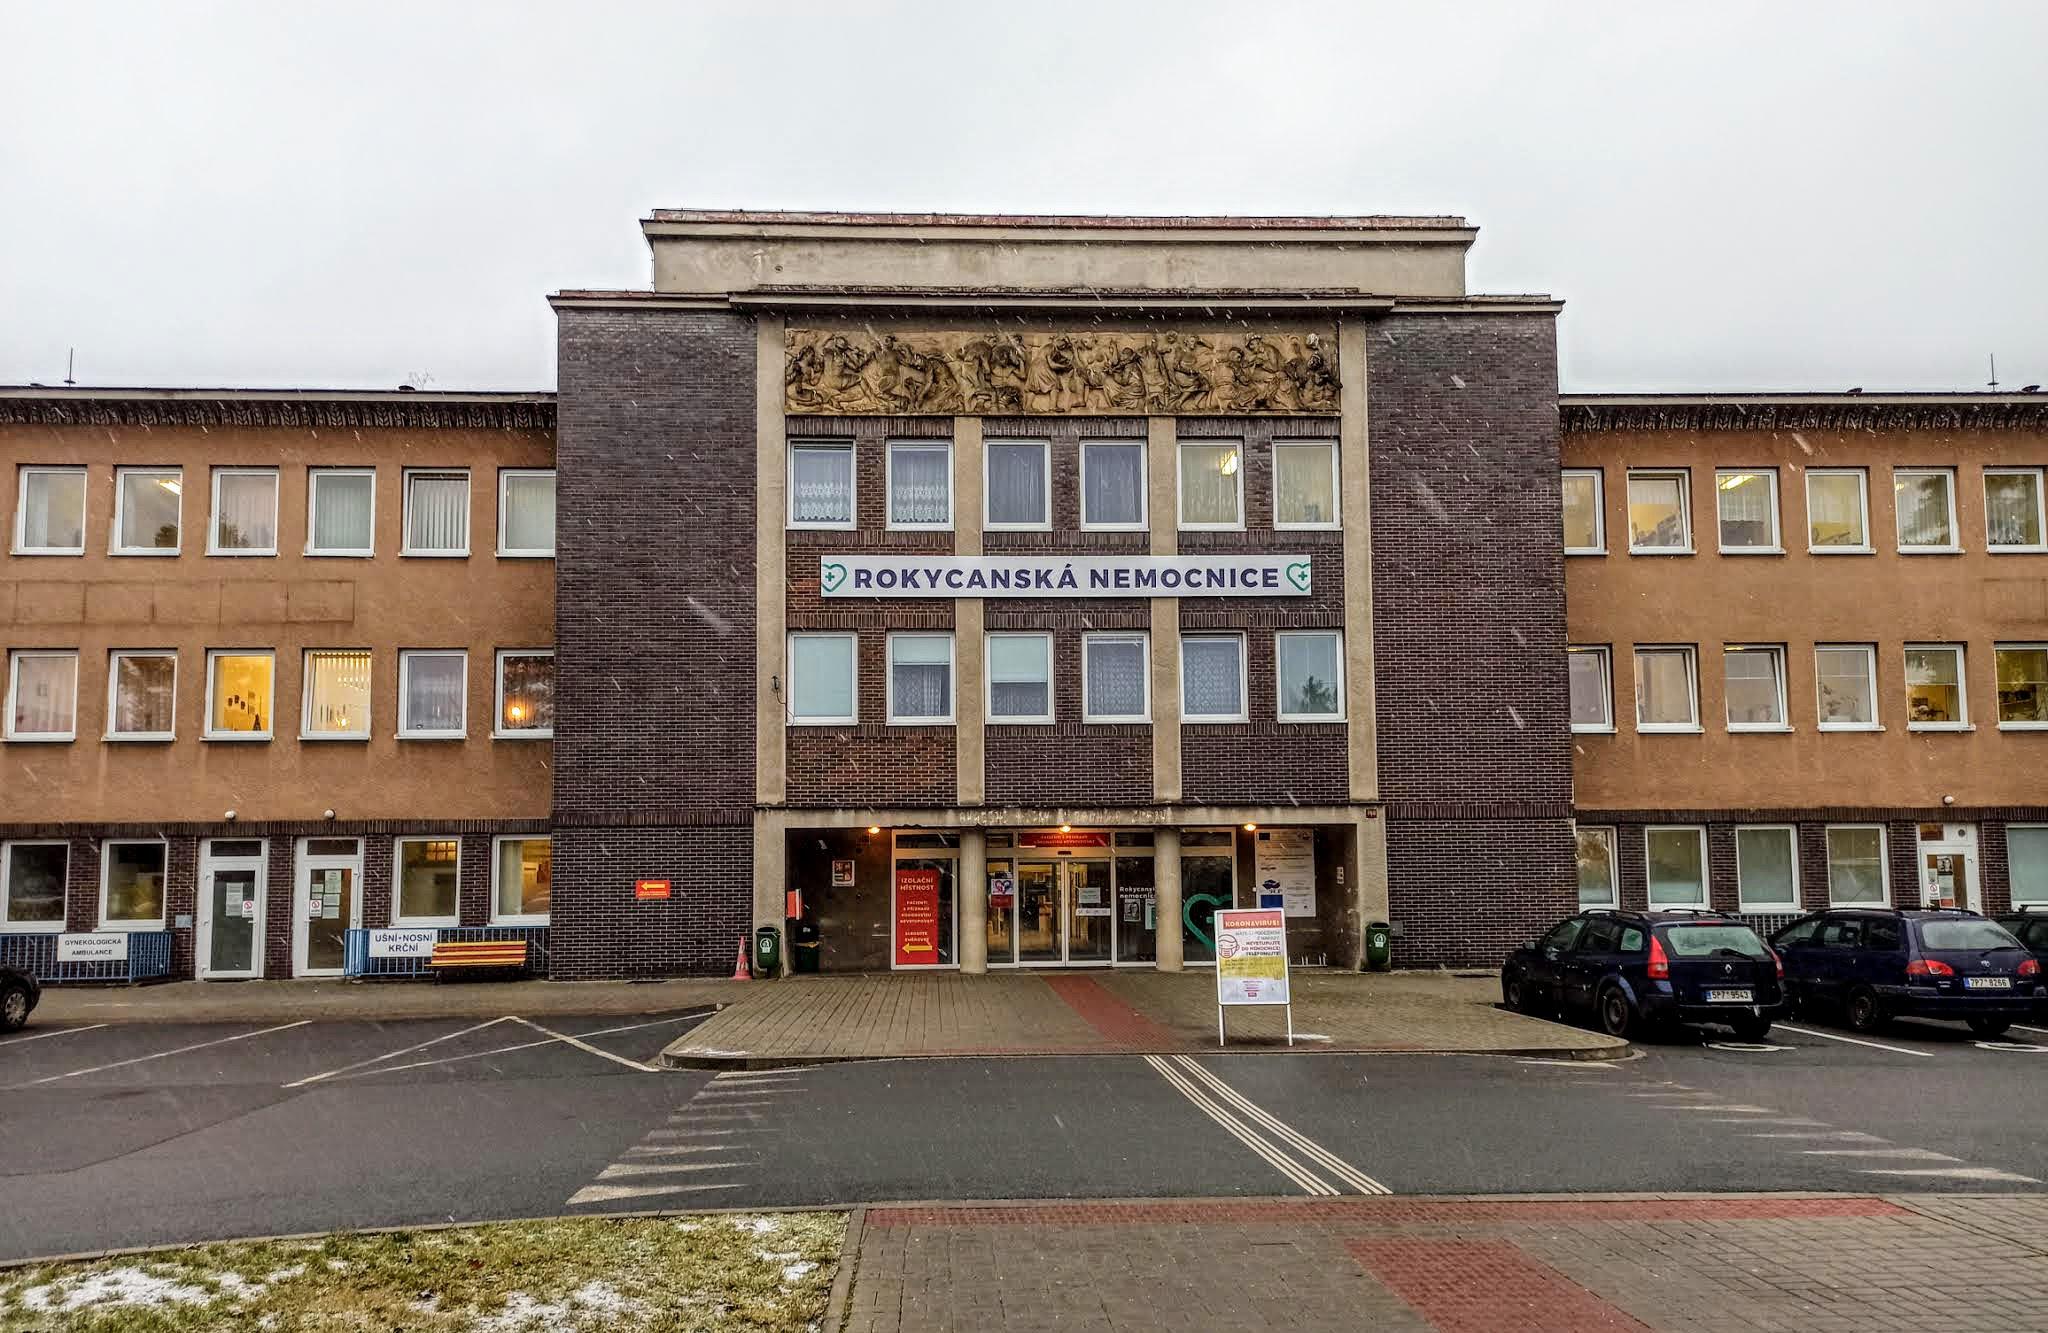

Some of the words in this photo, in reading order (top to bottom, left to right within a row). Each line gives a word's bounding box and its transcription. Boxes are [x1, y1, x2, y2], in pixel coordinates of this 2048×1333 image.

[855, 563, 1078, 589] ROKYCANSKÁ
[1090, 568, 1280, 588] NEMOCNICE
[1225, 919, 1280, 928] KORONAVIRUS!
[388, 943, 419, 952] KRČNÍ
